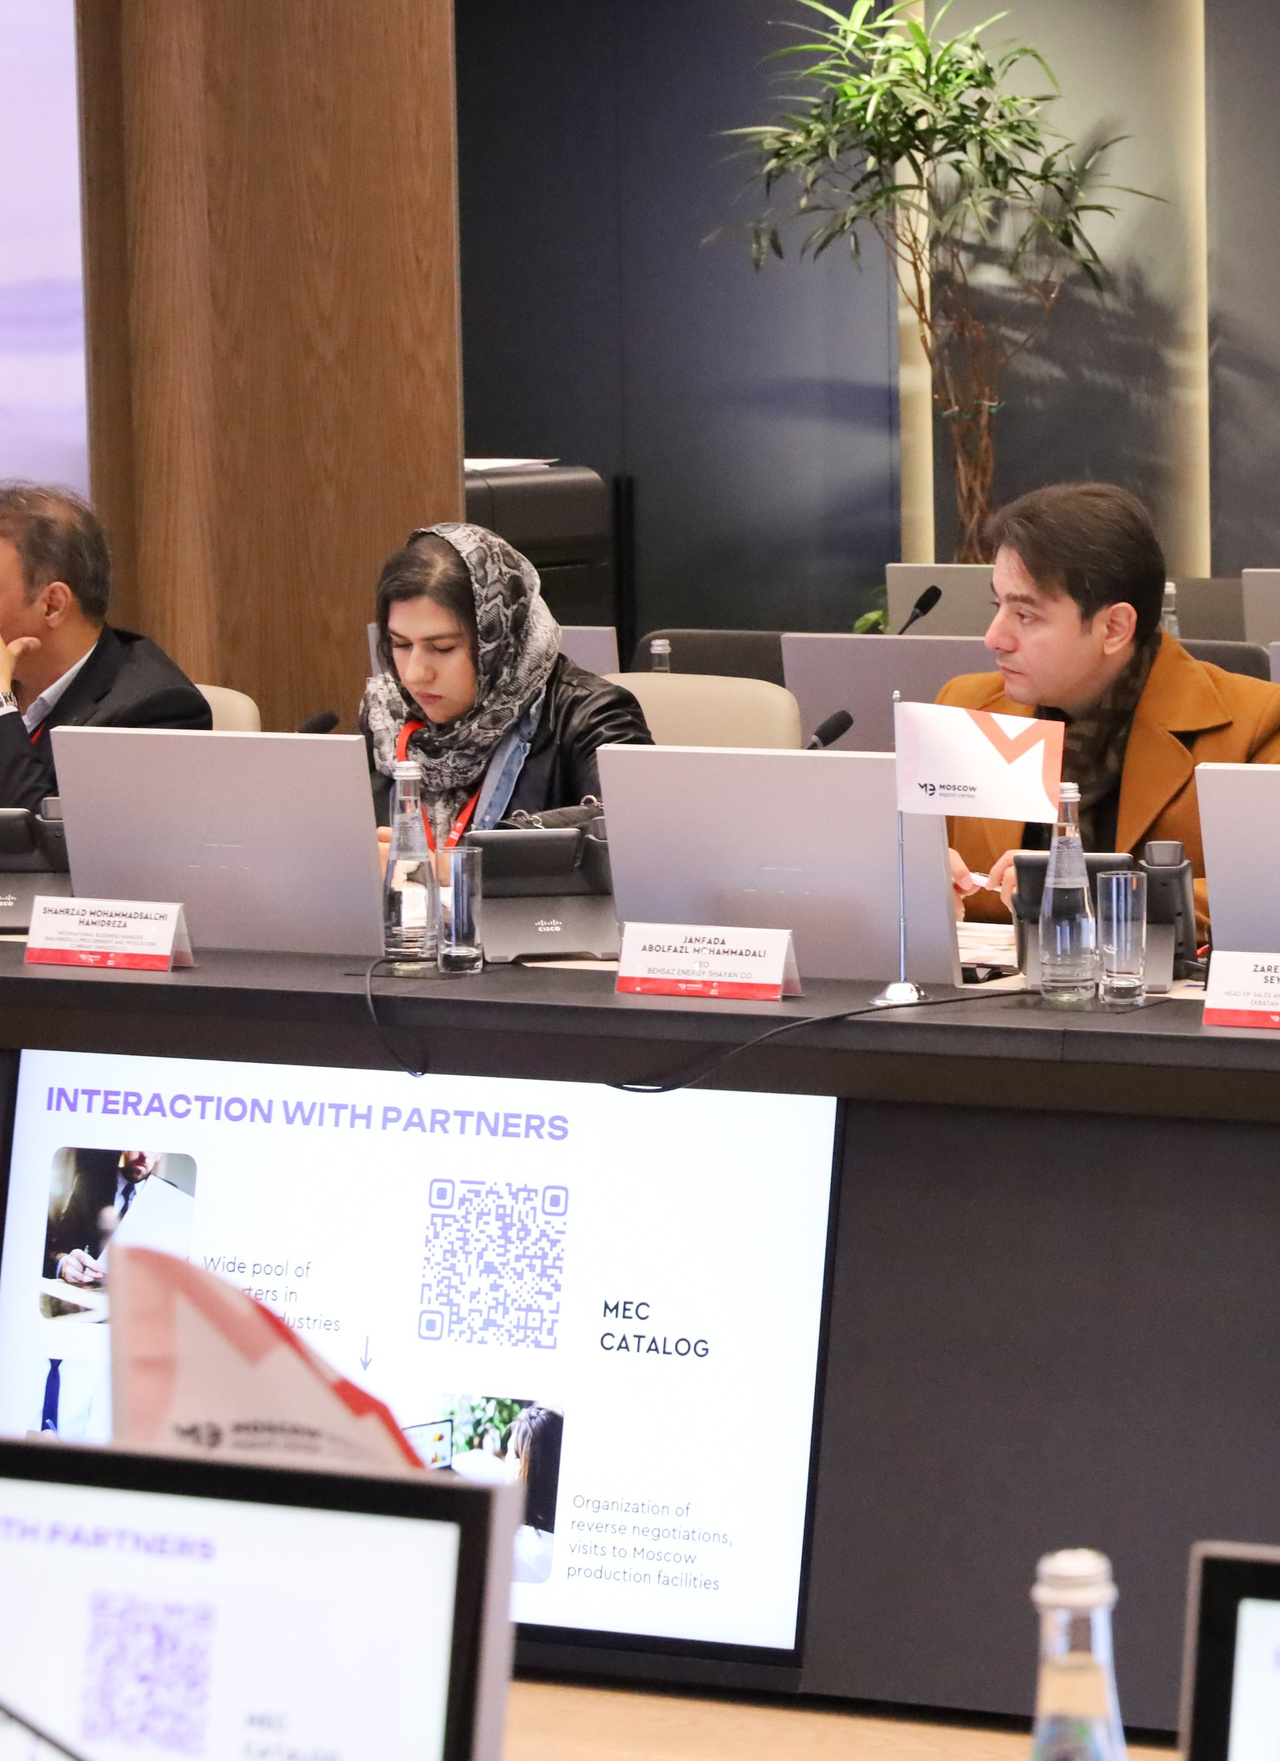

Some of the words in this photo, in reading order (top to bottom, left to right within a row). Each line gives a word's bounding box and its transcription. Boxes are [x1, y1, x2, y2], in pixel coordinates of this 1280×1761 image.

[939, 784, 977, 792] MOSCOW
[42, 906, 87, 917] SHAHRZAD
[78, 919, 128, 929] HAMIDREZA
[683, 935, 726, 945] JANFADA
[641, 944, 690, 954] ABOLFAZL
[647, 967, 676, 976] BEHSAZ
[677, 968, 706, 977] ENERGY
[708, 970, 738, 979] SHAYAN
[1250, 999, 1279, 1007] EKBATAN
[1253, 991, 1271, 999] SALES
[46, 1086, 274, 1125] INTERACTION
[282, 1099, 374, 1131] WITH
[380, 1105, 570, 1142] PARTNERS
[203, 1255, 247, 1274] Wide
[252, 1260, 289, 1278] pool
[294, 1261, 312, 1279] of
[284, 1286, 298, 1302] in
[603, 1299, 650, 1320] MEC
[600, 1332, 709, 1358] CATALOG
[573, 1494, 670, 1514] Organization
[675, 1502, 691, 1518] of
[571, 1520, 627, 1535] reverse
[632, 1524, 733, 1548] negotiations,
[569, 1540, 606, 1557] visits
[612, 1544, 628, 1559] to
[632, 1546, 697, 1565] Moscow
[566, 1564, 652, 1585] production
[656, 1569, 720, 1591] facilities
